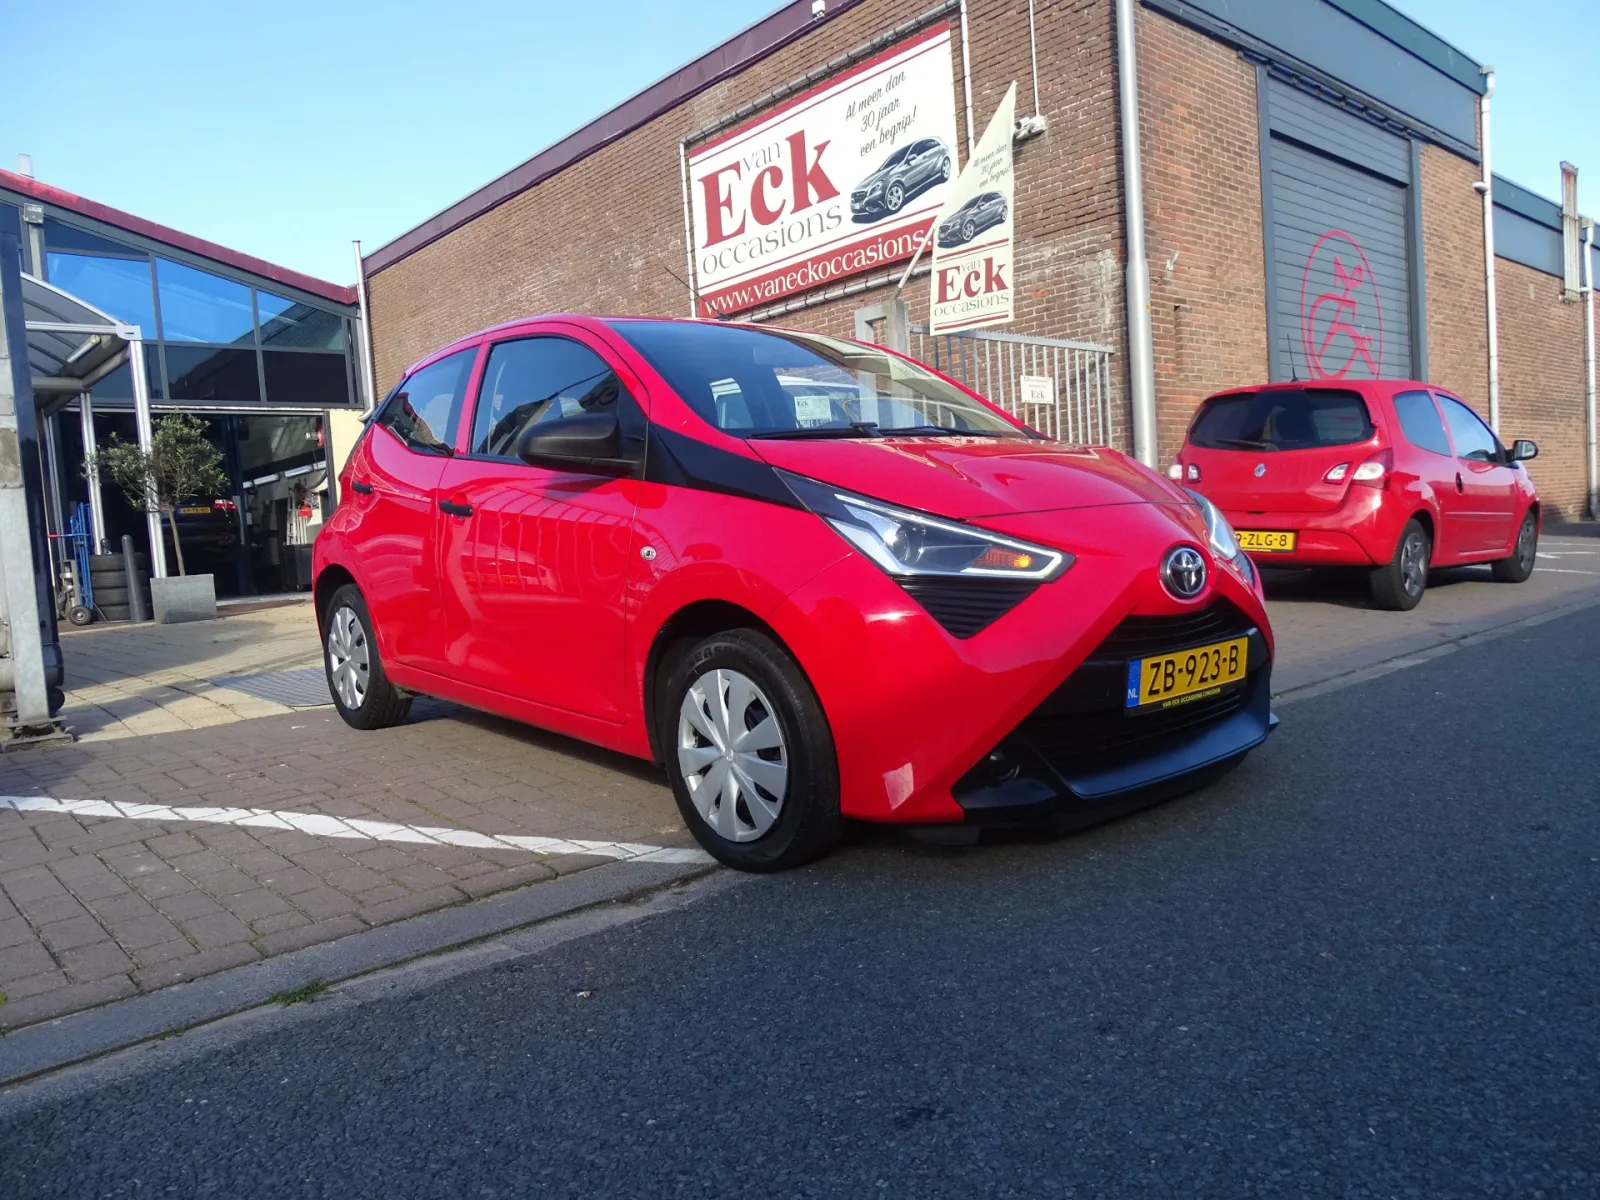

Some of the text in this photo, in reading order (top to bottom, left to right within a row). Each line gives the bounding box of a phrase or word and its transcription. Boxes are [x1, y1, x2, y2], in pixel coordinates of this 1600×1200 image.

[846, 71, 907, 122] Al meer dan
[860, 98, 901, 132] 30 jaar
[860, 104, 917, 157] een begrip!
[743, 142, 781, 172] van
[980, 163, 990, 175] 30
[697, 129, 841, 249] Eck
[702, 205, 843, 275] occasions
[705, 229, 933, 315] www.vaneckoccasions.
[935, 256, 1009, 305] Eck
[961, 260, 981, 272] van
[934, 292, 1010, 317] occasions
[1030, 389, 1046, 400] Eck
[1147, 644, 1239, 697] ZB-923-B
[1127, 687, 1138, 699] NL
